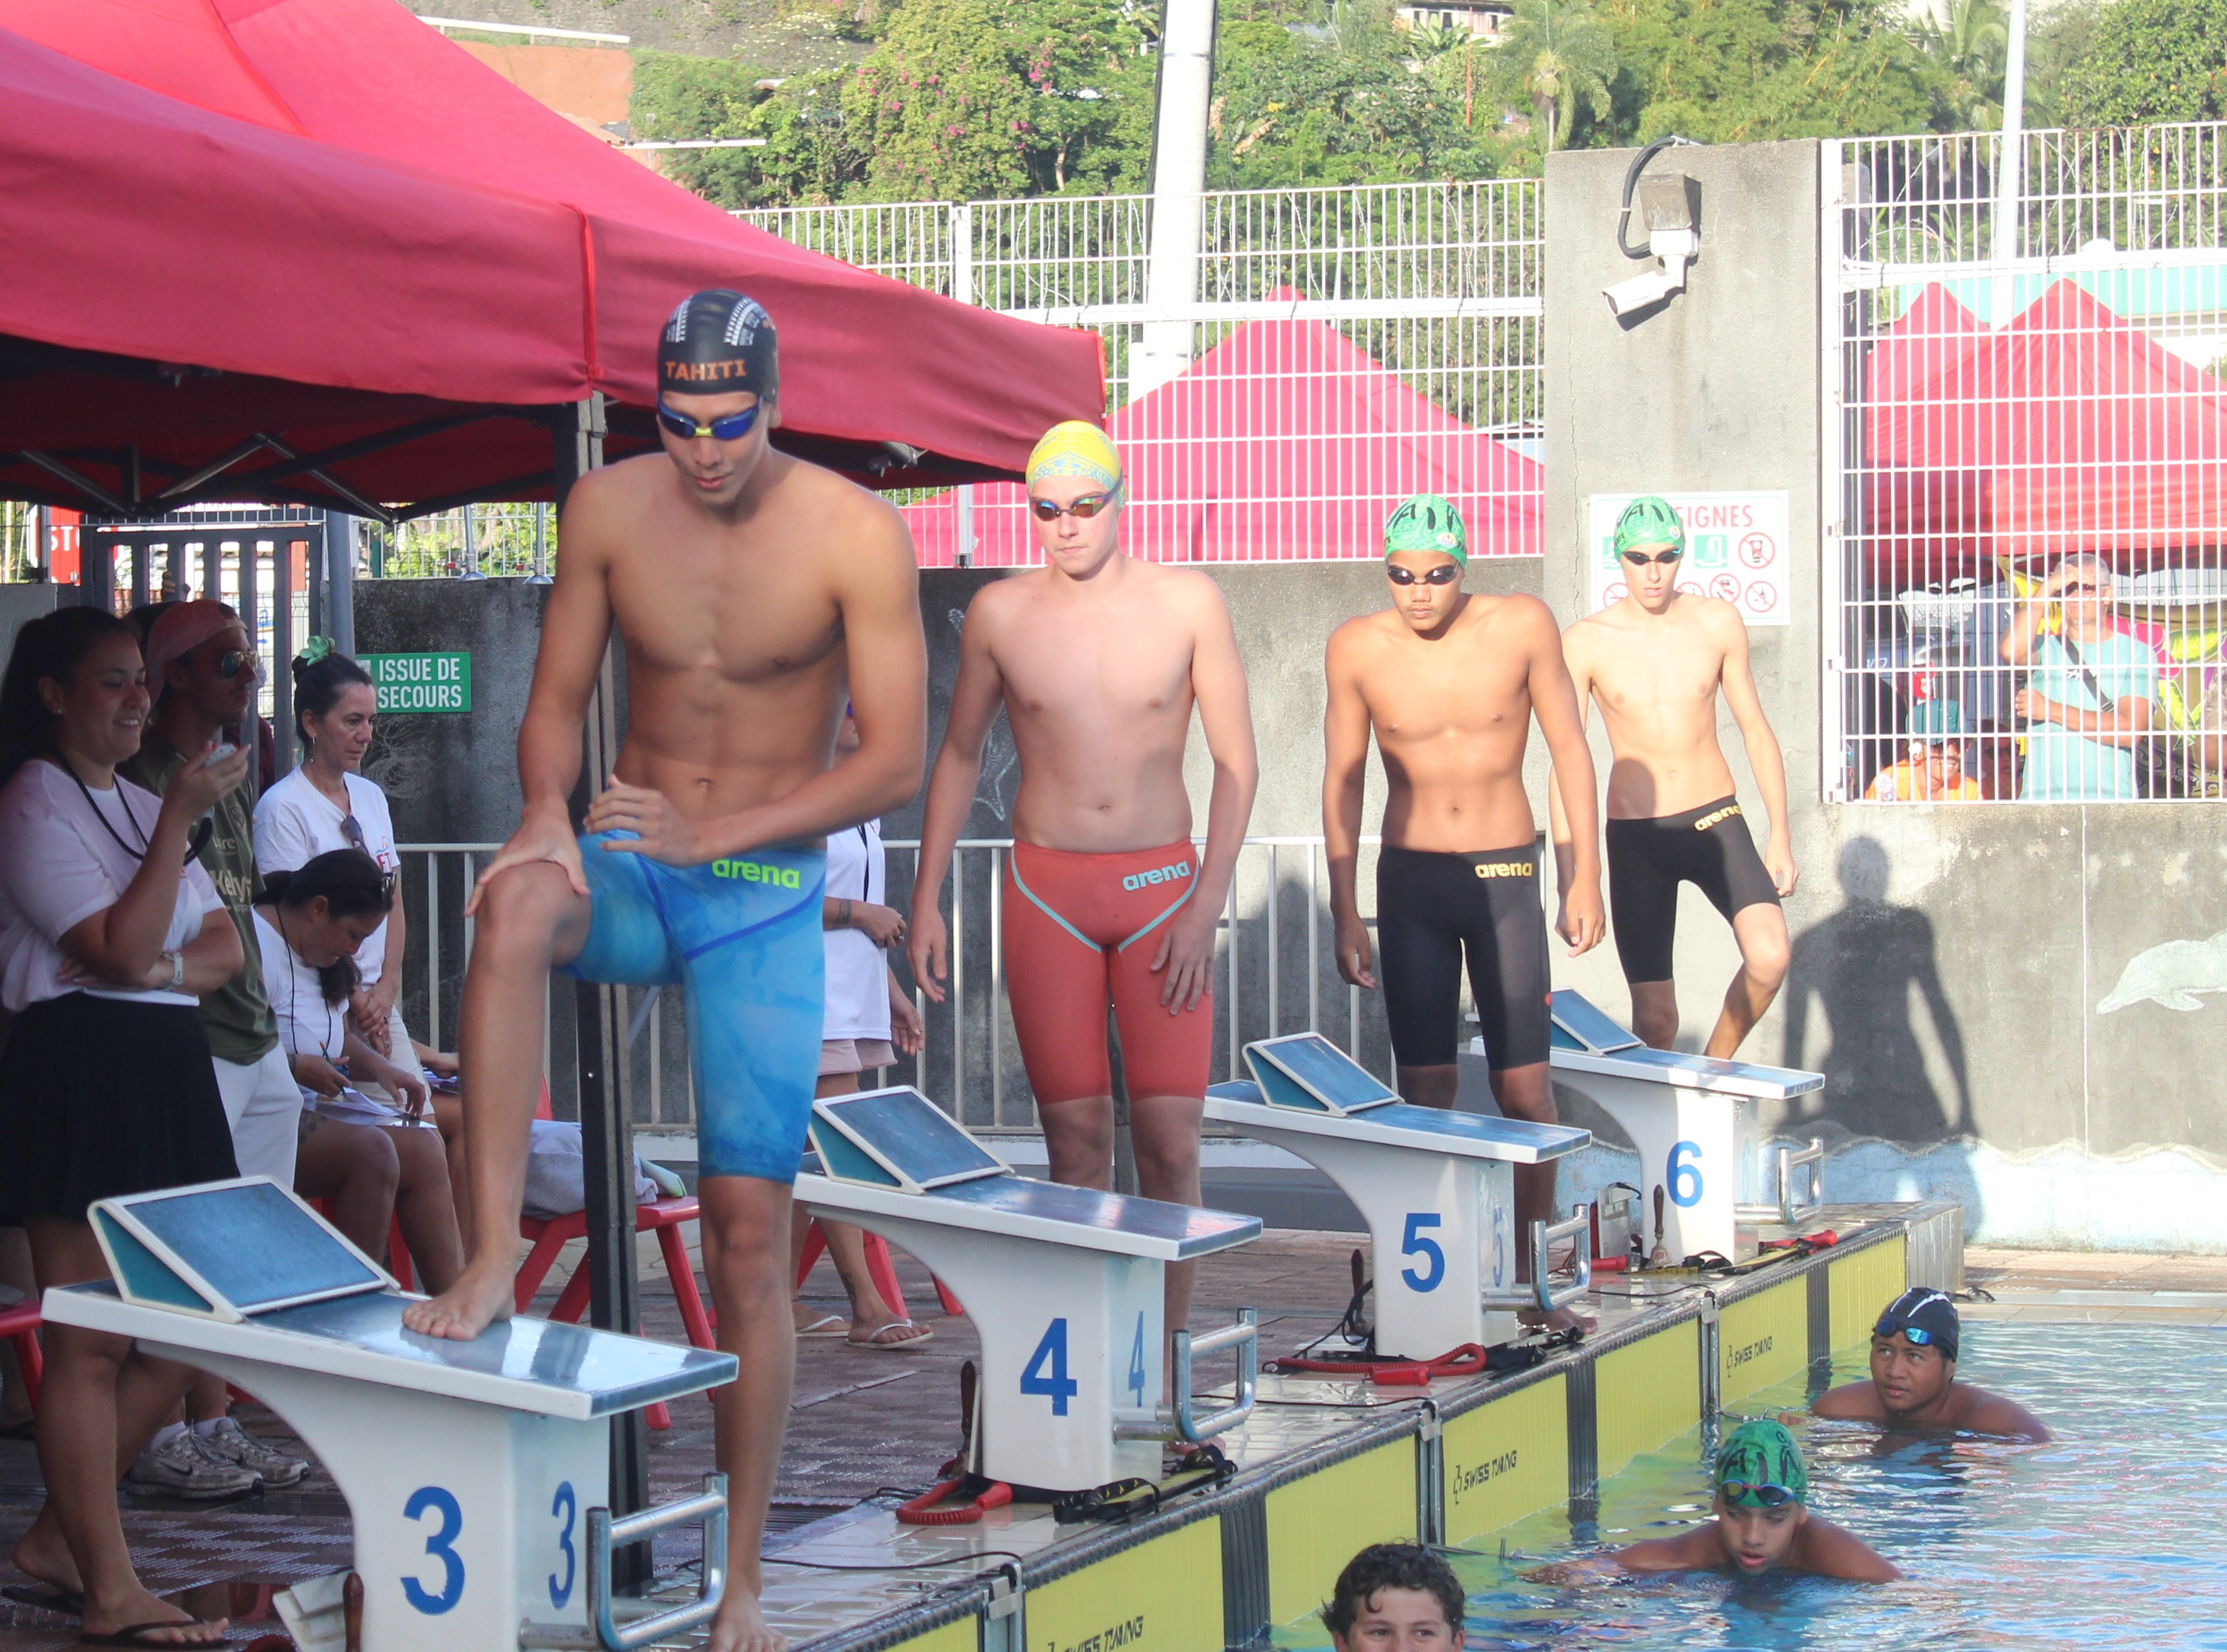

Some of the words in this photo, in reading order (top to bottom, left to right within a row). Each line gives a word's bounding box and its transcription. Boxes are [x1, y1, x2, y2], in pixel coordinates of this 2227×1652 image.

[665, 359, 747, 381] TAHITI
[379, 658, 432, 682] ISSUE
[437, 658, 461, 680] DE
[378, 685, 462, 708] SECOURS
[1694, 805, 1742, 831] arena
[712, 859, 800, 889] arena
[1123, 861, 1191, 891] arena
[1475, 863, 1533, 878] arena
[1666, 1140, 1704, 1208] 6
[1401, 1213, 1445, 1293] 5
[1493, 1206, 1503, 1288] 5
[1020, 1318, 1078, 1416] 4
[1129, 1310, 1145, 1408] 4
[1463, 1463, 1490, 1492] SWISS
[1492, 1450, 1517, 1478] TIMING
[400, 1486, 465, 1615] 3
[548, 1481, 576, 1611] 3
